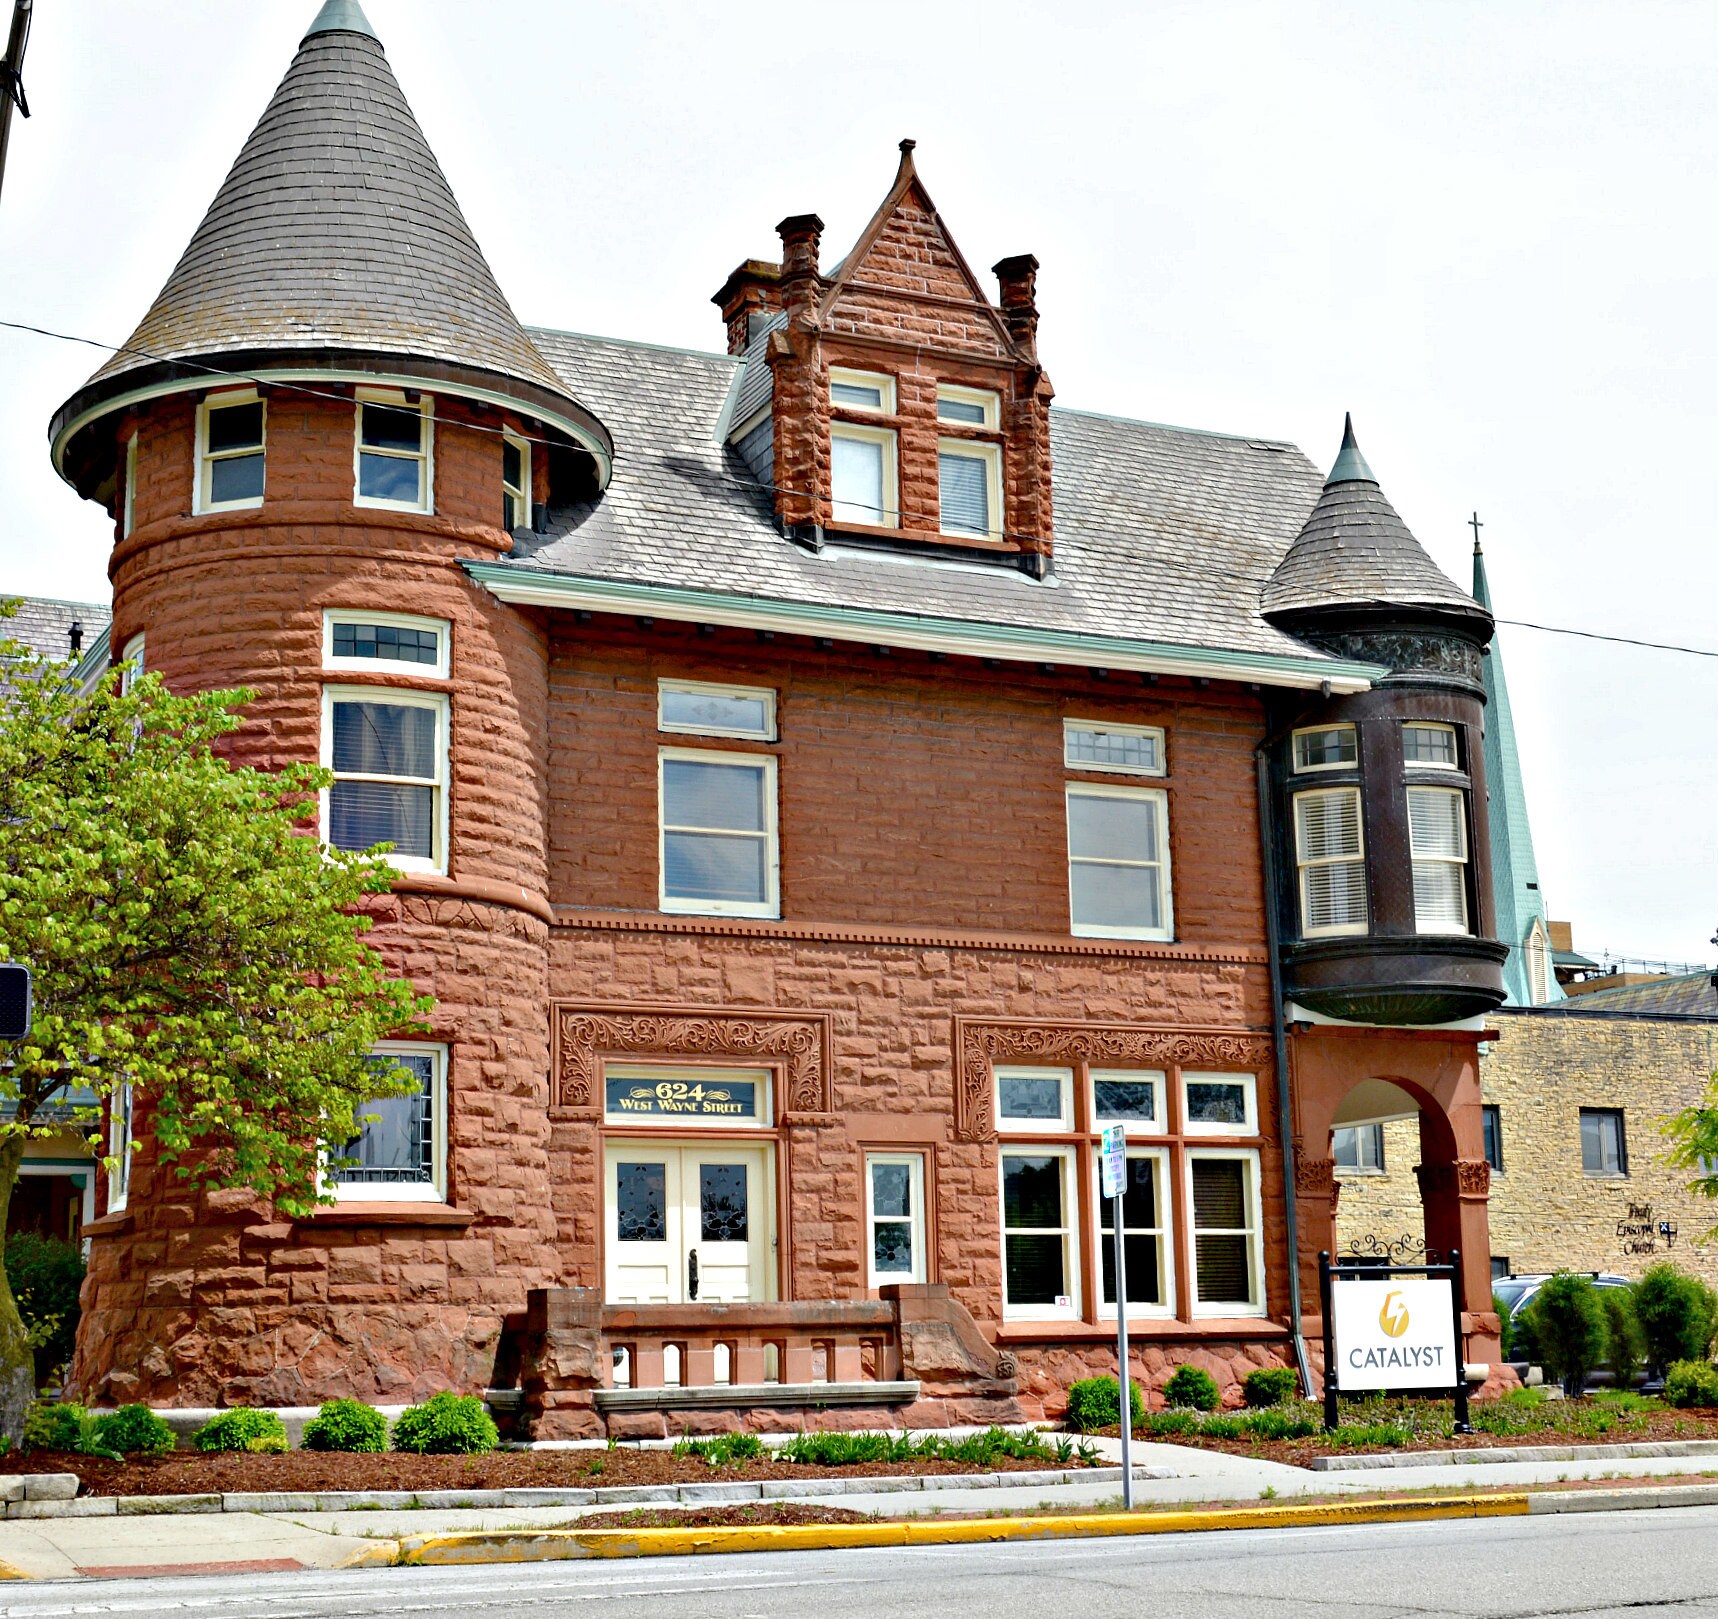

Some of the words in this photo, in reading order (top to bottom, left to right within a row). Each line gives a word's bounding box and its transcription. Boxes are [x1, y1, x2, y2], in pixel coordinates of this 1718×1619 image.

[655, 1082, 706, 1101] 624
[619, 1098, 653, 1111] WEST
[658, 1098, 698, 1112] WAYNE
[702, 1101, 743, 1114] STREET
[1349, 1346, 1444, 1369] CATALYST
